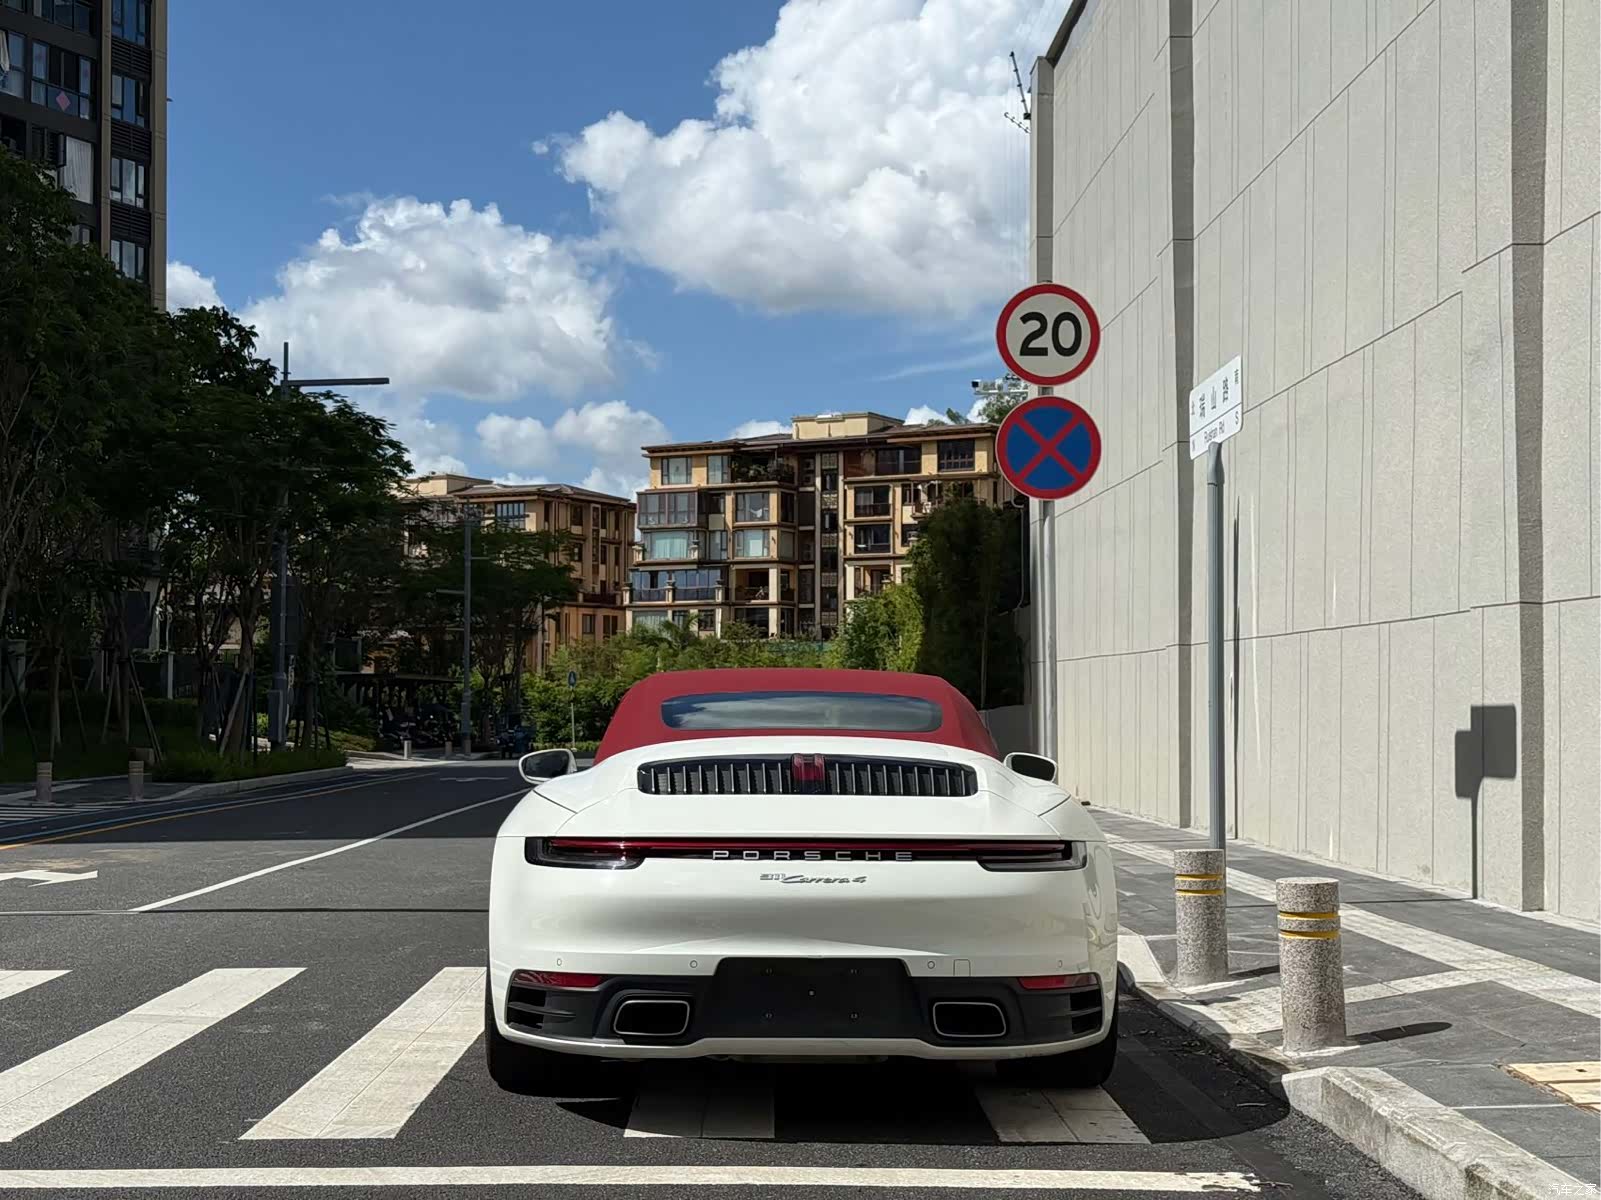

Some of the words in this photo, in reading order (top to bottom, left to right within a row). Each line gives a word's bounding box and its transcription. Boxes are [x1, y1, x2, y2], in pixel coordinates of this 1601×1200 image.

[1019, 311, 1083, 357] 20
[1218, 420, 1225, 435] Rd
[1234, 410, 1239, 425] S
[712, 850, 913, 861] PORSCHE
[760, 873, 786, 881] 911
[781, 874, 850, 884] Carrera
[852, 875, 867, 883] 4
